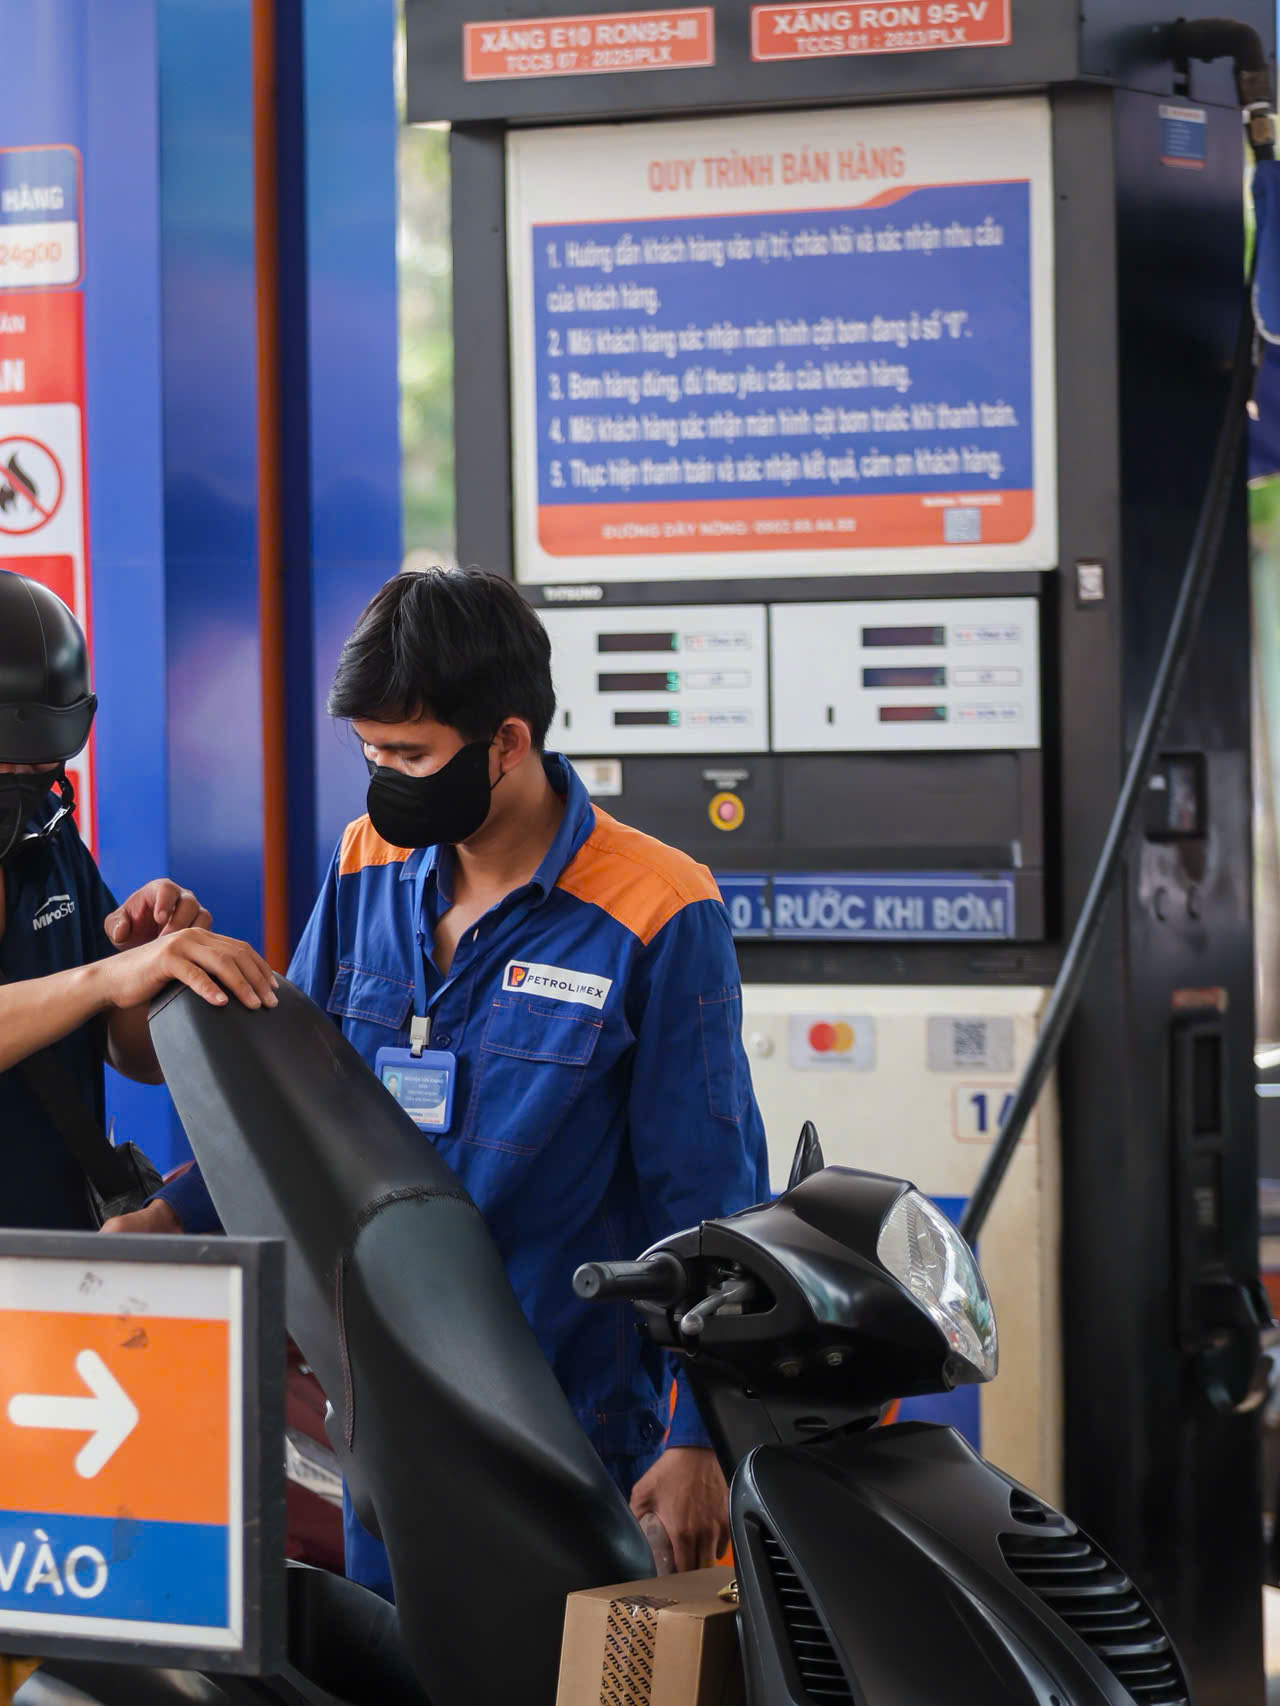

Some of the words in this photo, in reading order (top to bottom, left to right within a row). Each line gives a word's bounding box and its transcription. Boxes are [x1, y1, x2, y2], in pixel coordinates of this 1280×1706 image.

[773, 9, 853, 35] XĂNG
[859, 6, 919, 29] RON
[927, 1, 988, 24] 95-V
[480, 28, 546, 53] XĂNG
[550, 27, 591, 47] E10
[648, 158, 696, 192] QUY
[703, 148, 774, 189] TRÌNH
[781, 144, 831, 185] BÁN
[837, 141, 907, 181] HÀNG
[731, 904, 752, 928] 0
[874, 895, 927, 930] KHI
[932, 893, 1005, 930] BƠM
[526, 974, 604, 999] PETROLIMEX
